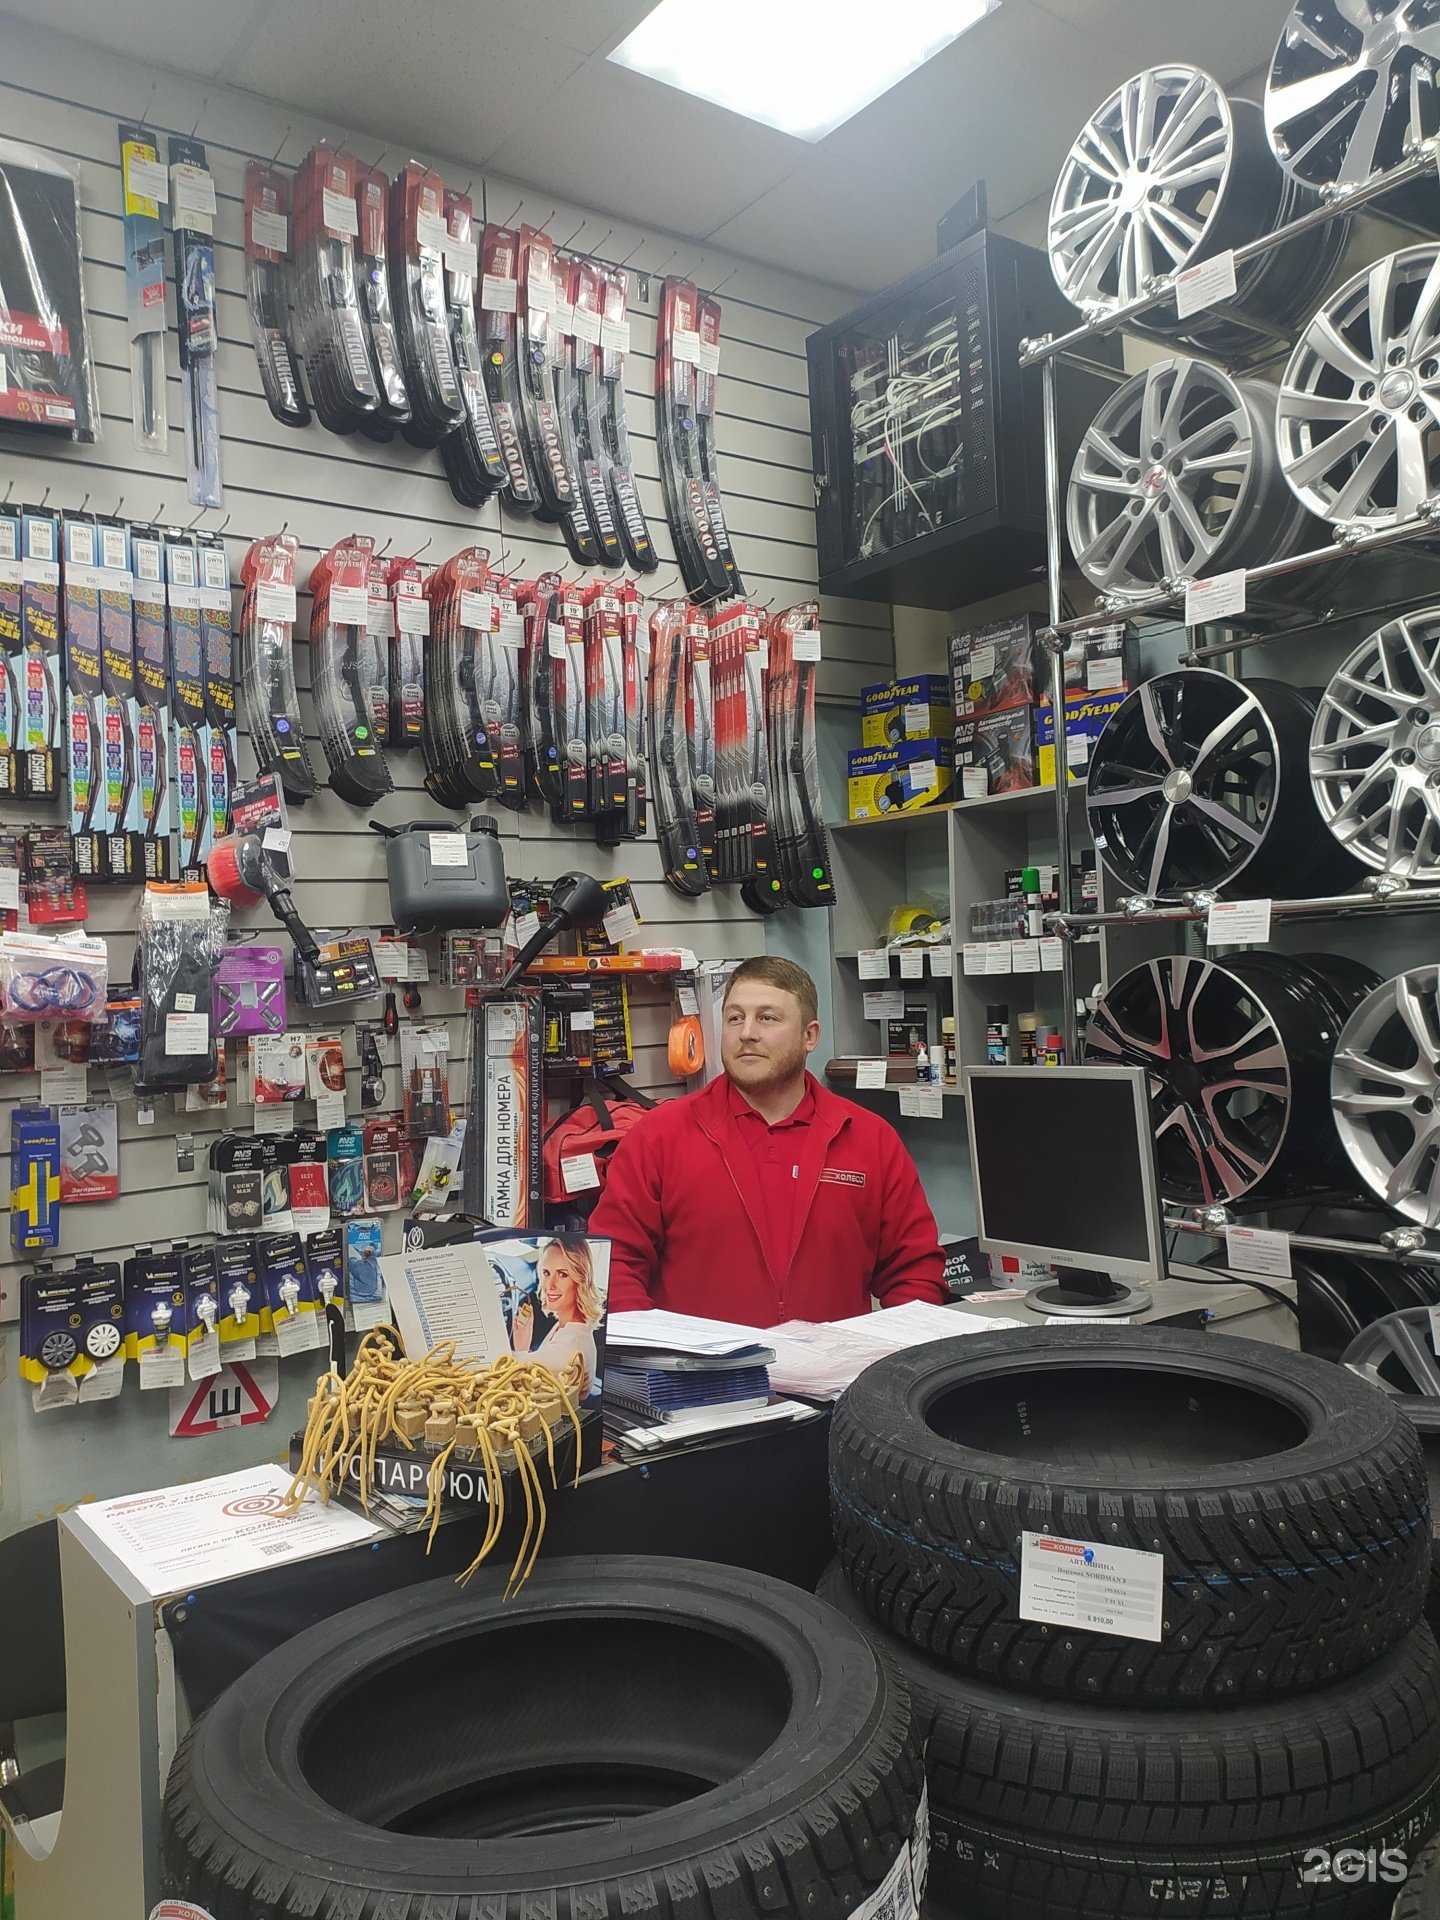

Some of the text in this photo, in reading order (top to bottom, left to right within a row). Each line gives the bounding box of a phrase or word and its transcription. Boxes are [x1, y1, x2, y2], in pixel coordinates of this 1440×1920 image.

[335, 549, 363, 562] AVS
[951, 634, 972, 650] AVS
[866, 682, 920, 703] GOODYEAR
[1043, 702, 1121, 725] GDYEAR
[954, 723, 975, 737] AVS
[851, 746, 899, 766] GOODYEAR
[529, 1046, 540, 1186] РОССИЙСКАЯ ФЕДЕРАЦИЯ
[338, 1136, 355, 1145] AVS
[373, 1132, 389, 1141] AVS
[299, 1141, 316, 1150] AVS
[496, 1074, 513, 1219] РАМКА ДЛЯ НОМЕРА
[233, 1150, 252, 1159] AVS
[835, 1172, 864, 1184] КОЛЕСО
[232, 1182, 255, 1190] LUCKY
[210, 1386, 241, 1418] Ш
[1054, 1543, 1084, 1554] КОЛЕСО
[1069, 1557, 1114, 1571] АВТОШИНА
[1085, 1571, 1122, 1584] NORDMAN
